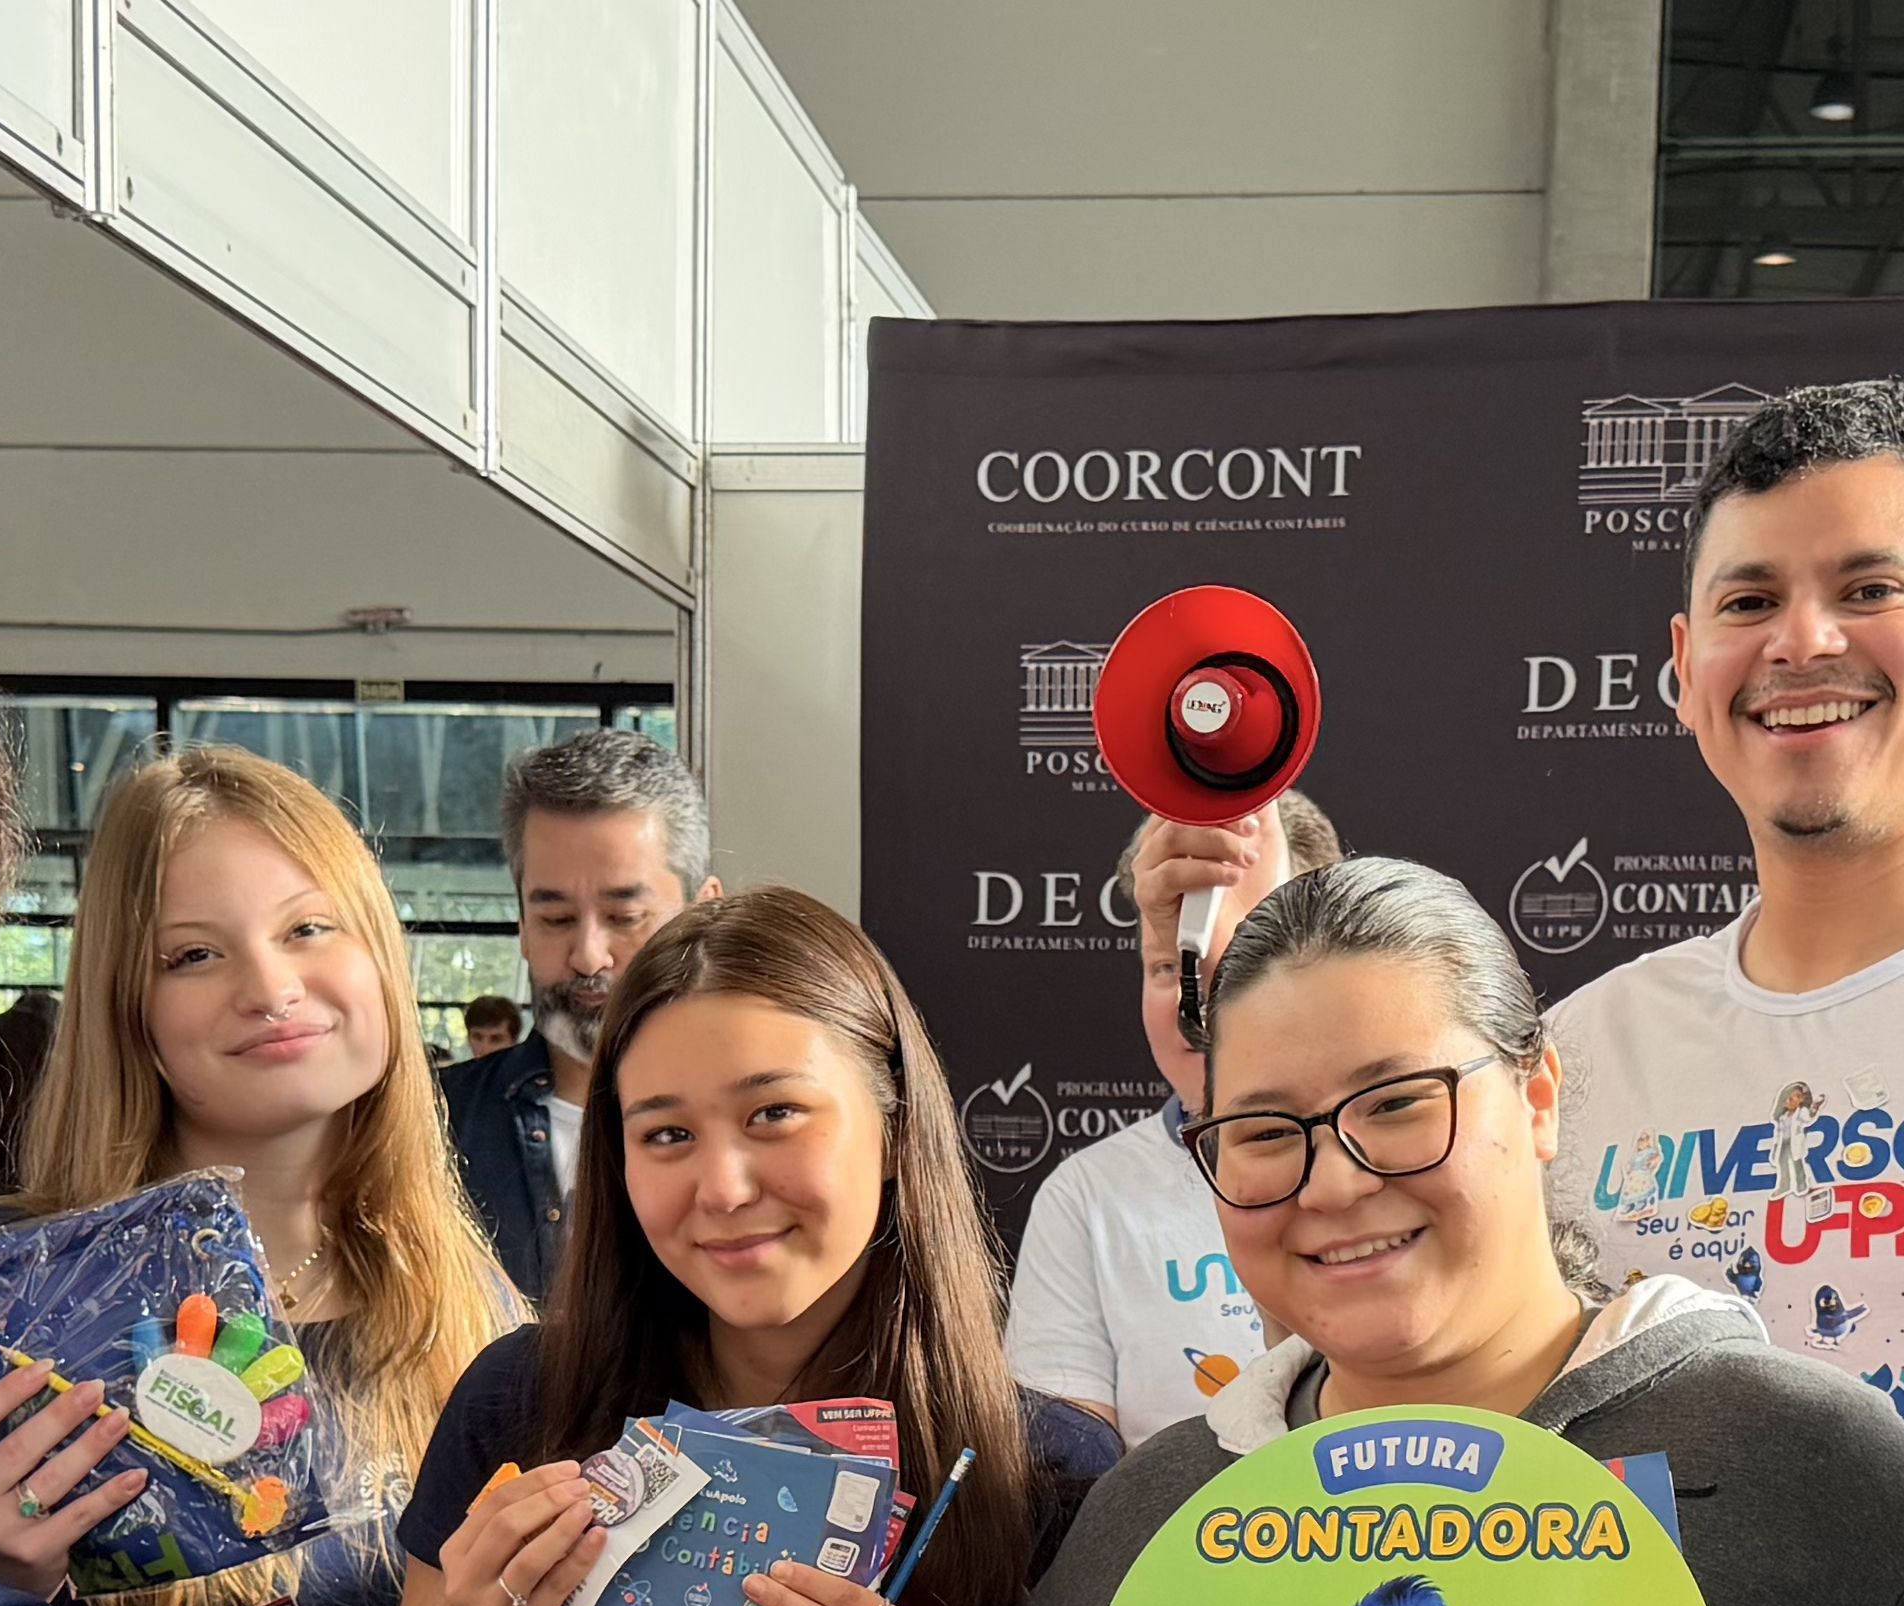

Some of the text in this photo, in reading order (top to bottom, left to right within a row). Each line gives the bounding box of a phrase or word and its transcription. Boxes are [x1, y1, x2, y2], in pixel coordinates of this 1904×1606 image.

[977, 445, 1362, 503] COORCONT
[1517, 722, 1668, 739] DEPARTAMENTO
[1026, 751, 1112, 775] POSC
[1613, 854, 1735, 872] PROGRAMA DE
[973, 872, 1138, 927] DEC
[967, 936, 1105, 950] DEPARTAMENTO
[1057, 1081, 1145, 1097] PROGRAMA
[148, 1375, 237, 1441] FISCAL
[1328, 1434, 1481, 1478] FUTURA
[1197, 1502, 1629, 1563] CONTADORA
